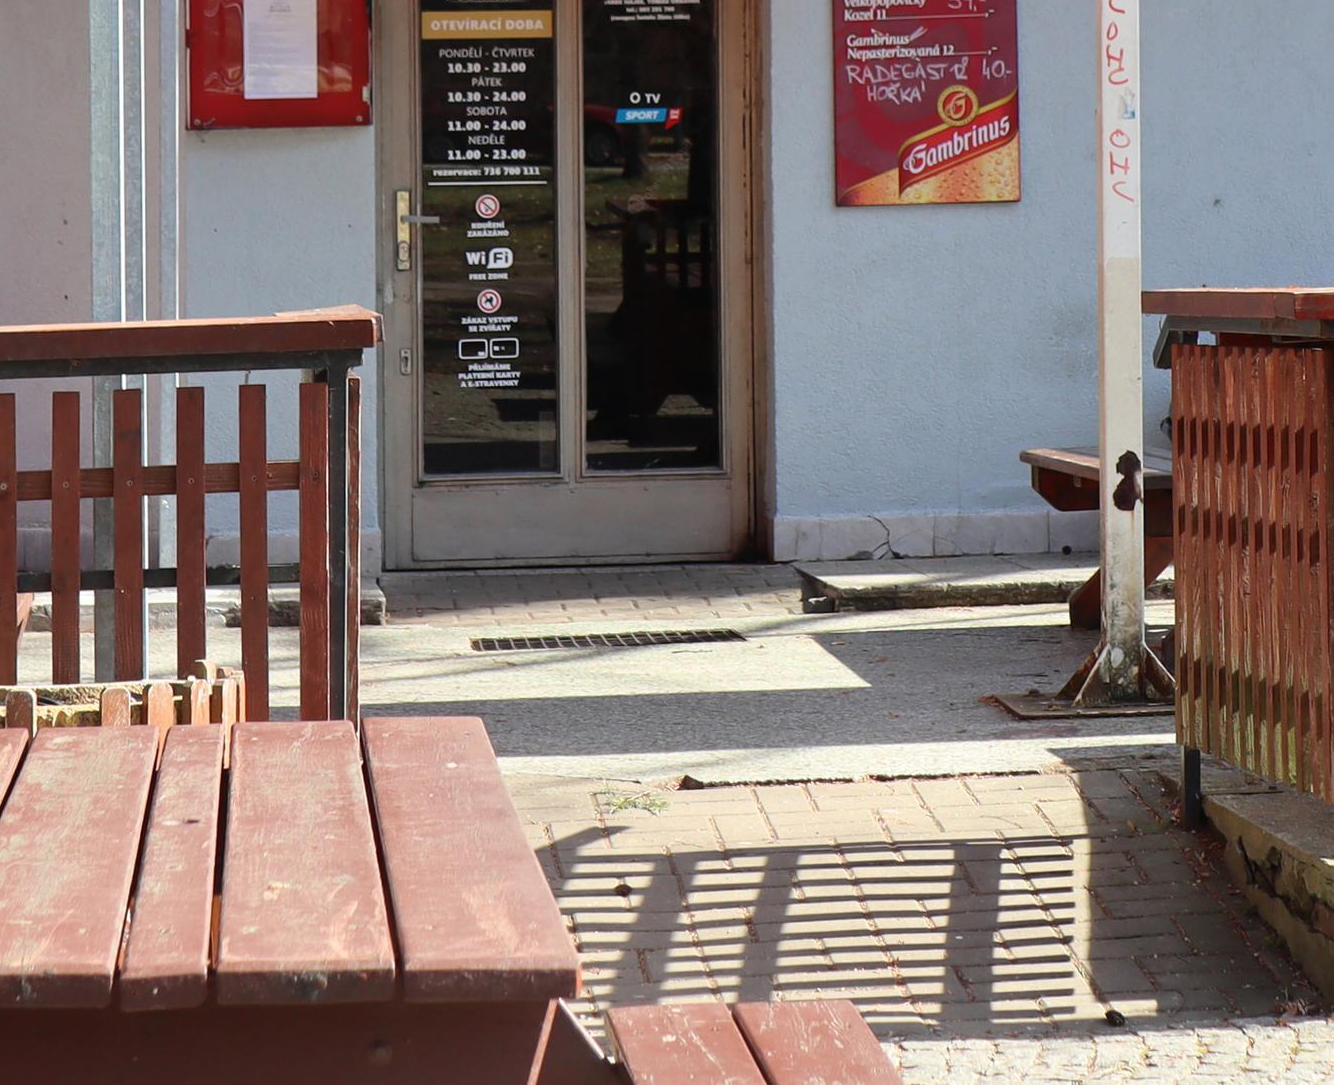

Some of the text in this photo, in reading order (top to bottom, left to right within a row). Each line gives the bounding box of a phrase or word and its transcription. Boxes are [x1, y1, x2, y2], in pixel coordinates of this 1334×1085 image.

[844, 7, 874, 22] Kozel
[431, 17, 544, 31] OTEVÍRACÍ DOBA
[846, 31, 910, 48] Gambrinus
[438, 46, 483, 58] PONDĚLÍ
[491, 46, 535, 57] ČTVRTEK
[942, 45, 955, 56] 12
[448, 63, 481, 73] 10.30
[492, 62, 526, 72] 23.00
[845, 61, 949, 85] RADEGAST
[471, 76, 502, 86] PÁTEK
[448, 92, 481, 102] 10.30
[492, 91, 526, 101] 24.00
[644, 93, 661, 104] TV
[466, 106, 507, 116] SOBOTA
[625, 110, 660, 120] SPORT
[448, 121, 481, 131] 11.00
[492, 120, 526, 130] 24.00
[468, 133, 505, 145] NEDĚLE
[902, 115, 1010, 175] Gambrinus
[448, 150, 481, 160] 11.00
[492, 149, 526, 159] 23.00
[433, 167, 482, 176] rezervace:
